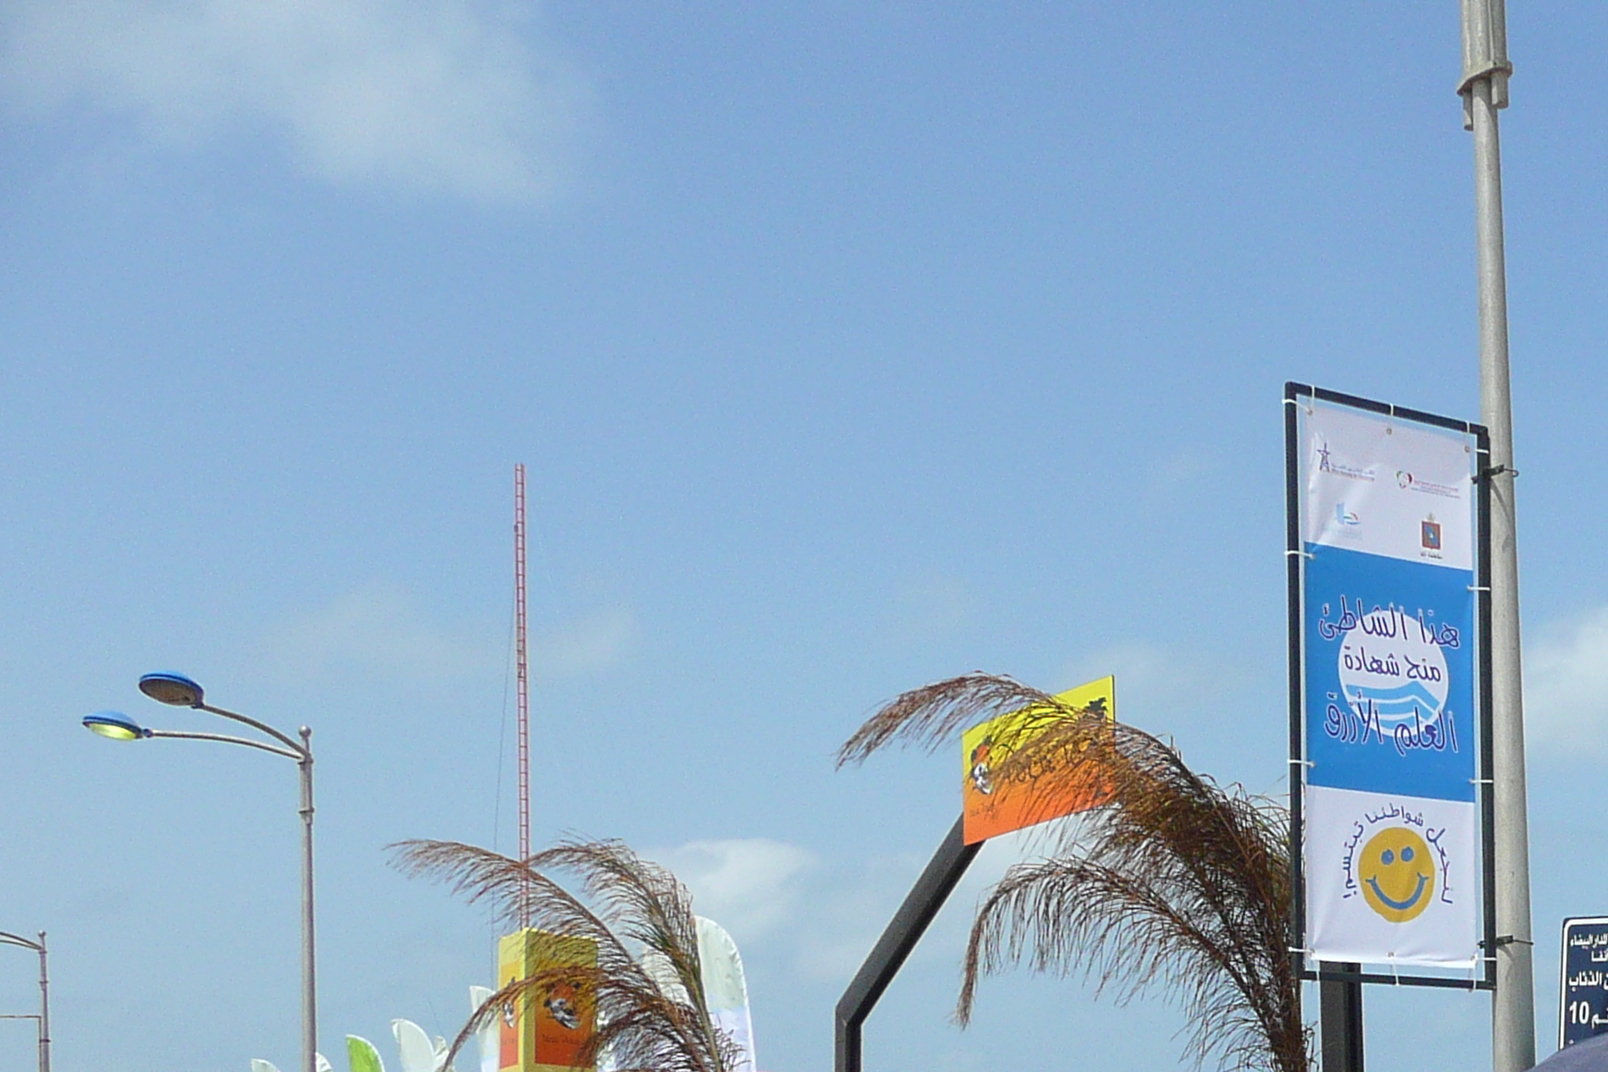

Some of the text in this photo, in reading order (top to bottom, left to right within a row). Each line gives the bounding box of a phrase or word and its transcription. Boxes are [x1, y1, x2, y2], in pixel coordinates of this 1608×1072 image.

[1318, 594, 1461, 649] هذا الشاطئ
[1343, 645, 1442, 682] منح شهادة
[1394, 706, 1459, 757] العلم
[1568, 970, 1602, 992] الذئاب
[1569, 1001, 1590, 1024] 10
